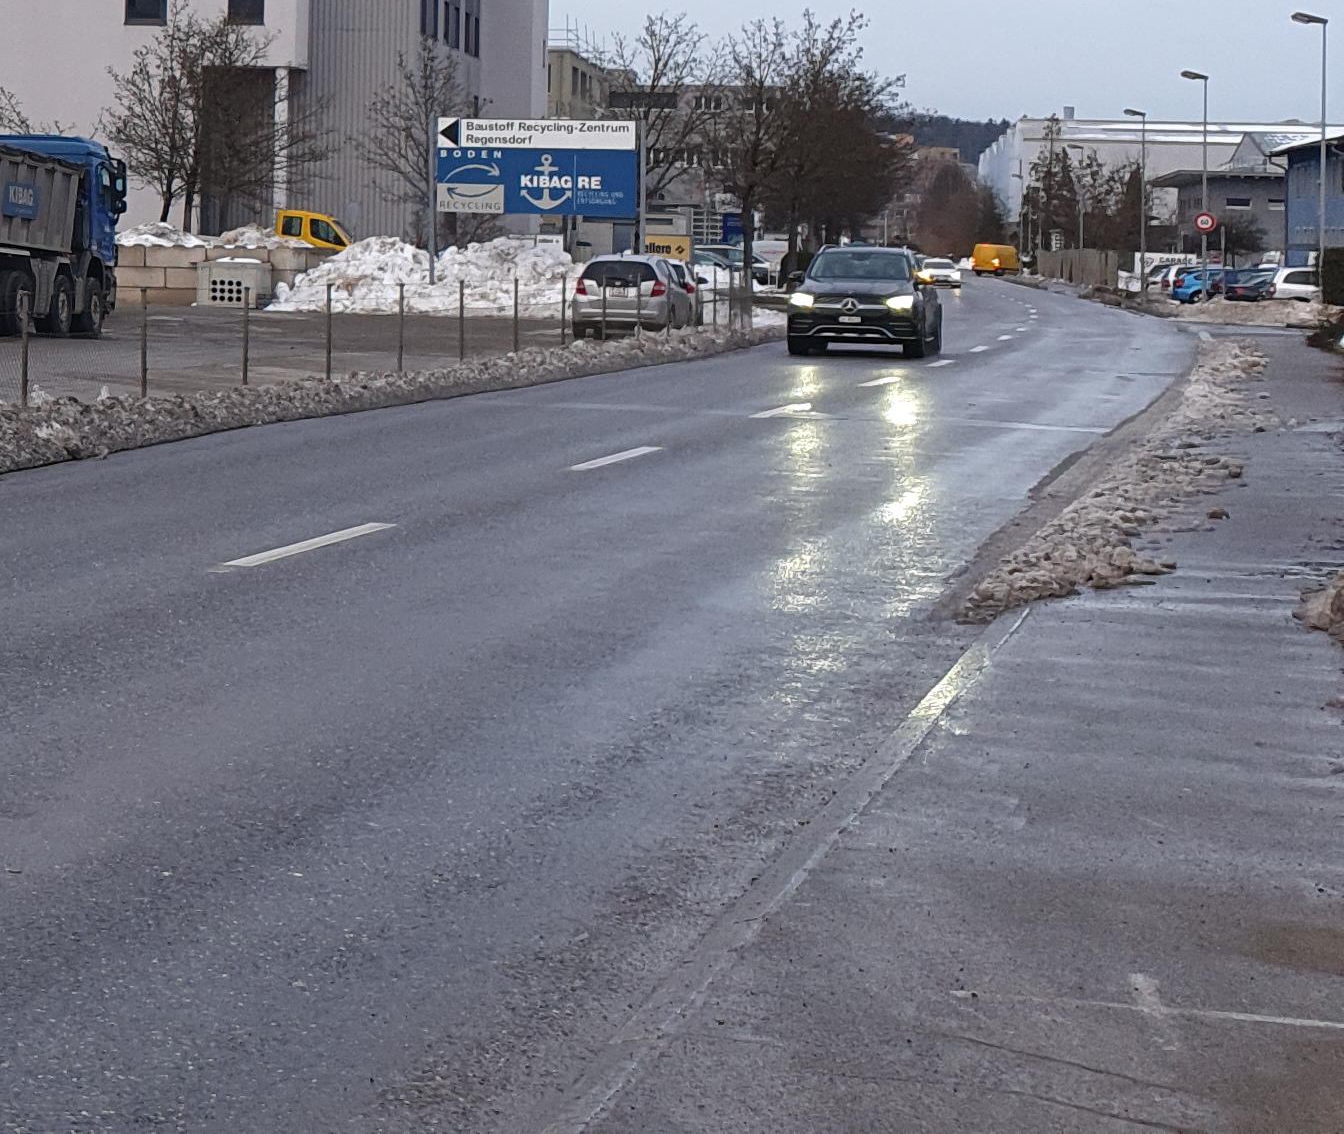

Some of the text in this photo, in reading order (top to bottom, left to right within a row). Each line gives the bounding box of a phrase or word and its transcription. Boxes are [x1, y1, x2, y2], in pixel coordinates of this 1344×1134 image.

[465, 121, 630, 135] Baustoff Recycling-Zentrum
[465, 134, 534, 146] Regensdorf
[439, 150, 502, 159] BODEN
[520, 174, 602, 190] KIBAG RE
[439, 200, 502, 211] RECYCLING
